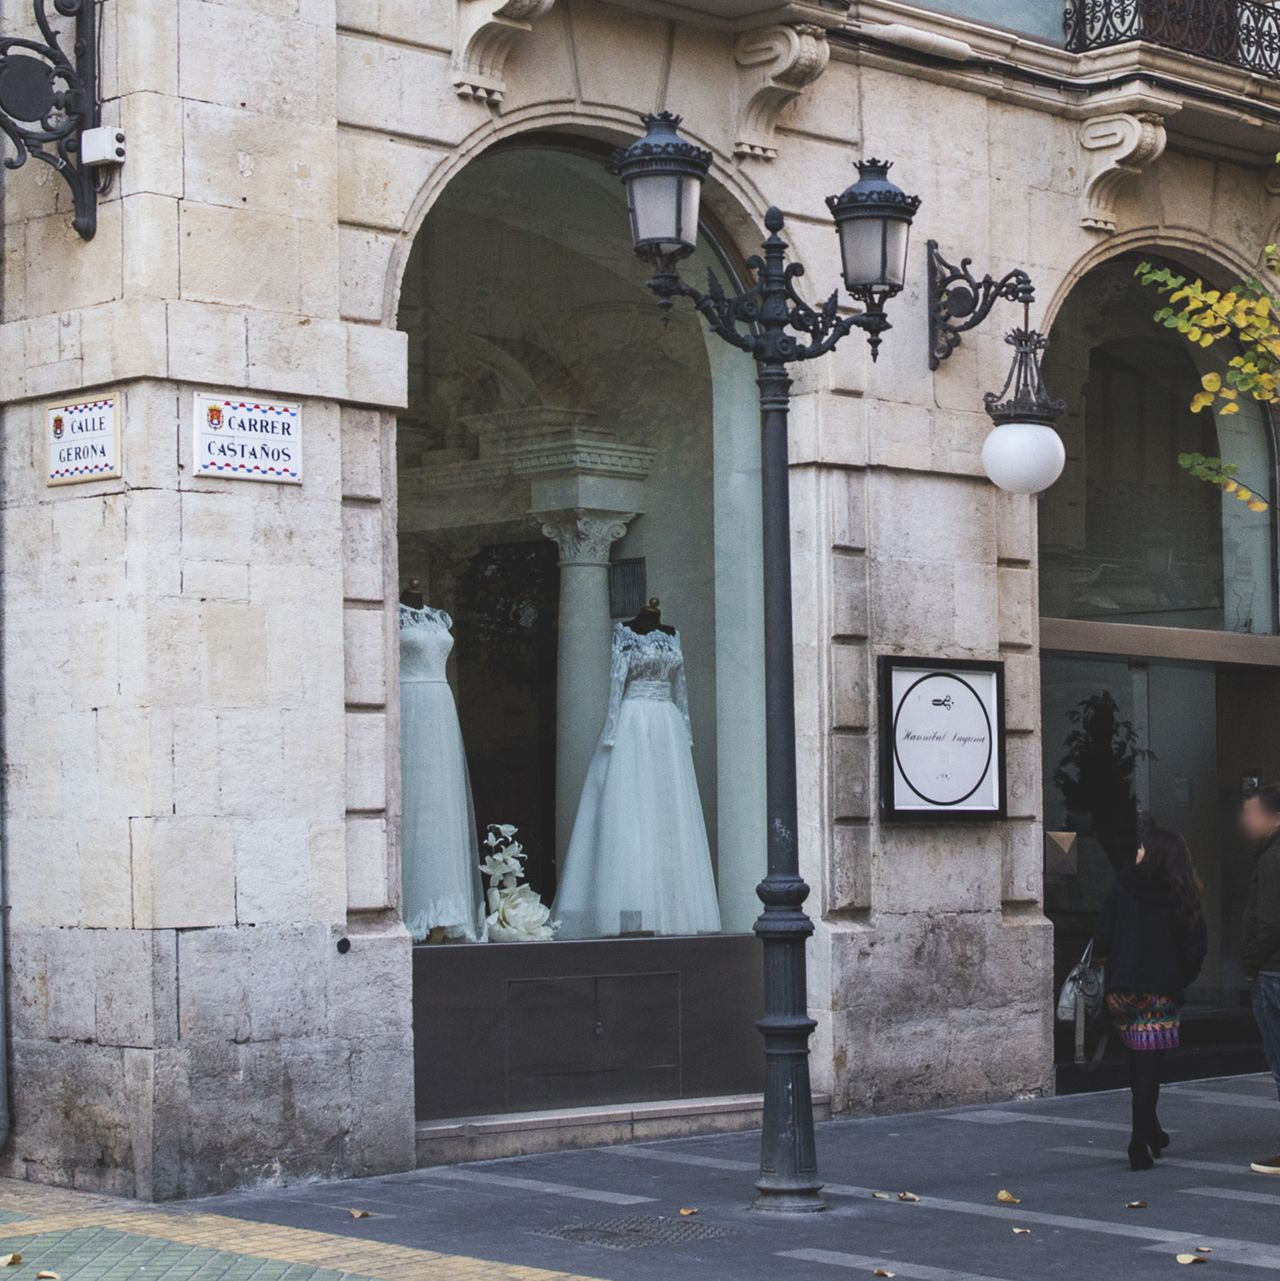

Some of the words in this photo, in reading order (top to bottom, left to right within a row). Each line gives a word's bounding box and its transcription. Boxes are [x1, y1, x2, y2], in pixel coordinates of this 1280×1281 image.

[70, 415, 107, 435] CALLE
[228, 415, 292, 436] CARRER
[59, 444, 106, 463] GERONA
[207, 440, 292, 462] CASTAÑOS
